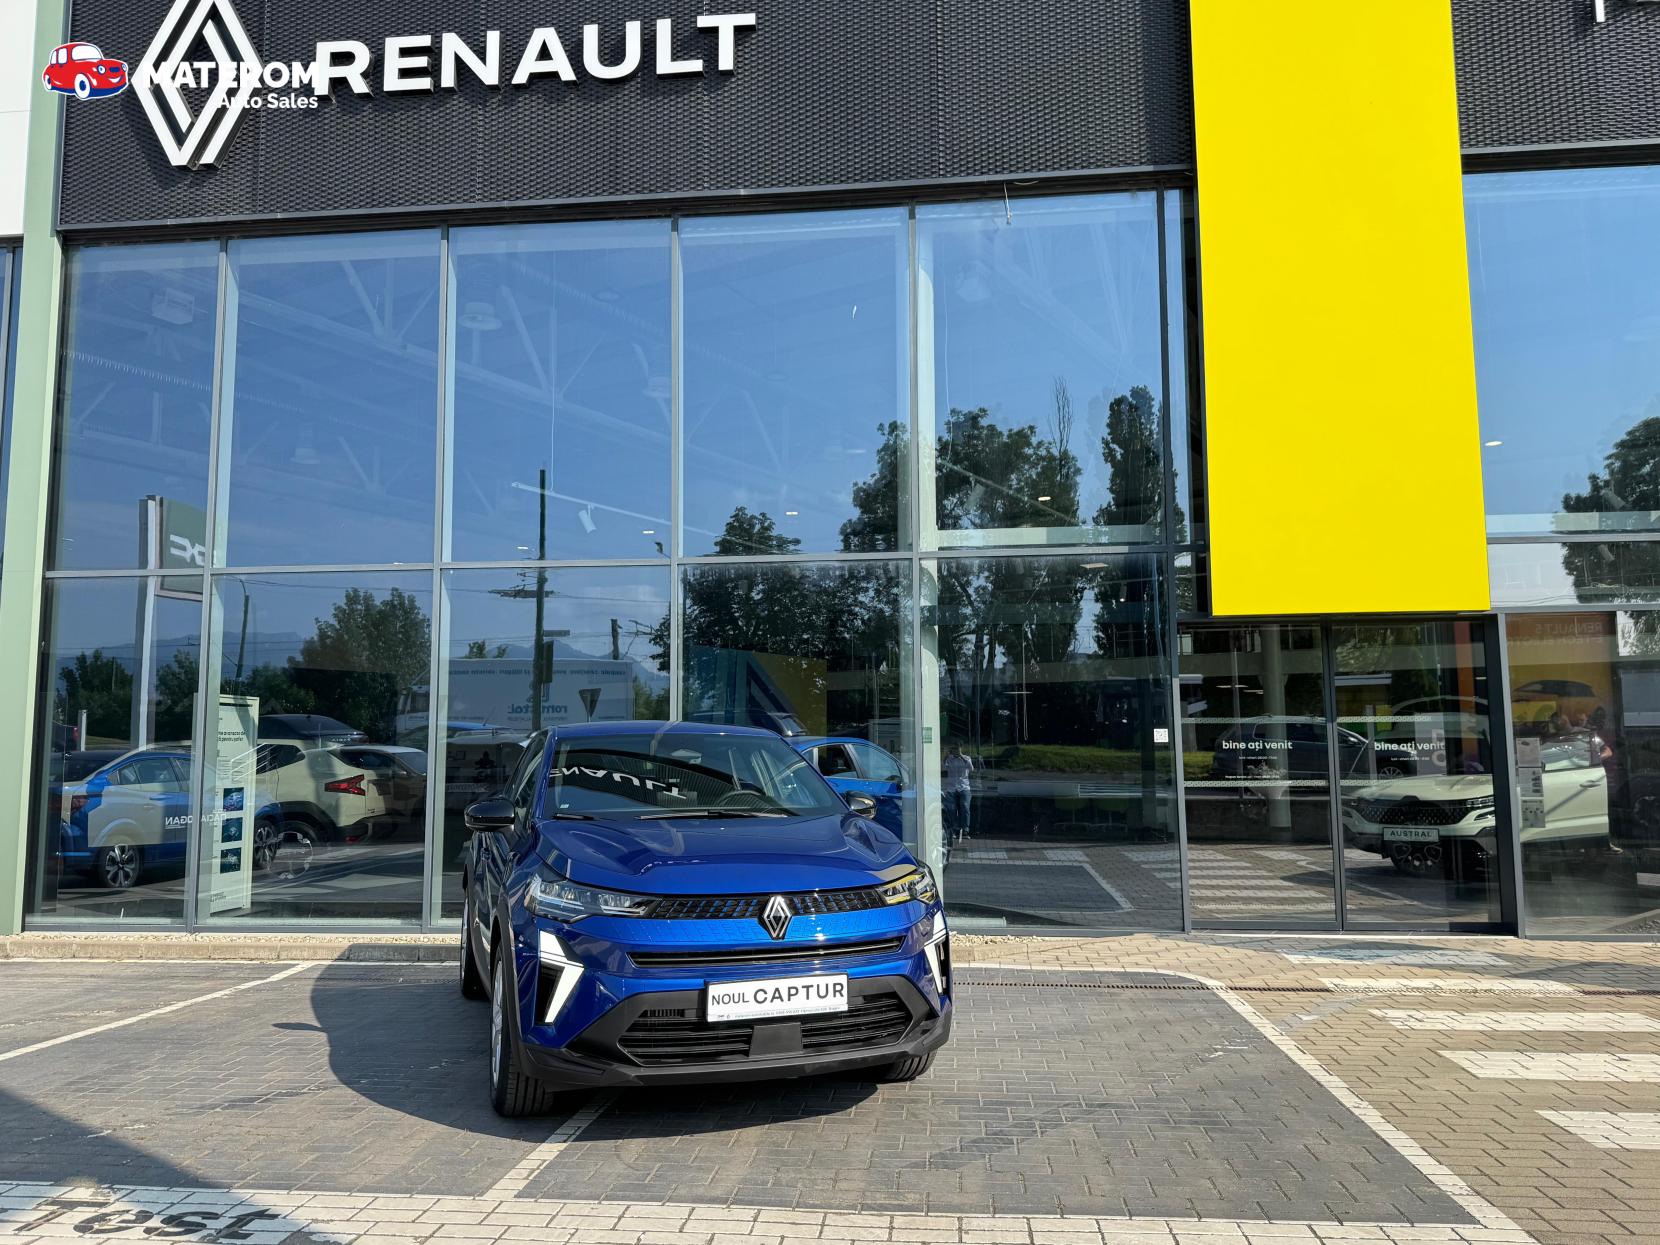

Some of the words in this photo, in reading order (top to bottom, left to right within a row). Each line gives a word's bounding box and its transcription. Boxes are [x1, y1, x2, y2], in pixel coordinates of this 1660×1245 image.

[314, 13, 756, 97] RENAULT
[1222, 740, 1246, 750] bine
[1265, 740, 1293, 750] venit
[1374, 741, 1398, 751] bine
[1416, 741, 1446, 751] venit
[1390, 830, 1432, 838] AUSTRAL
[711, 991, 749, 1006] NOUL
[753, 981, 845, 1004] CAPTUR
[13, 1198, 282, 1240] Test
